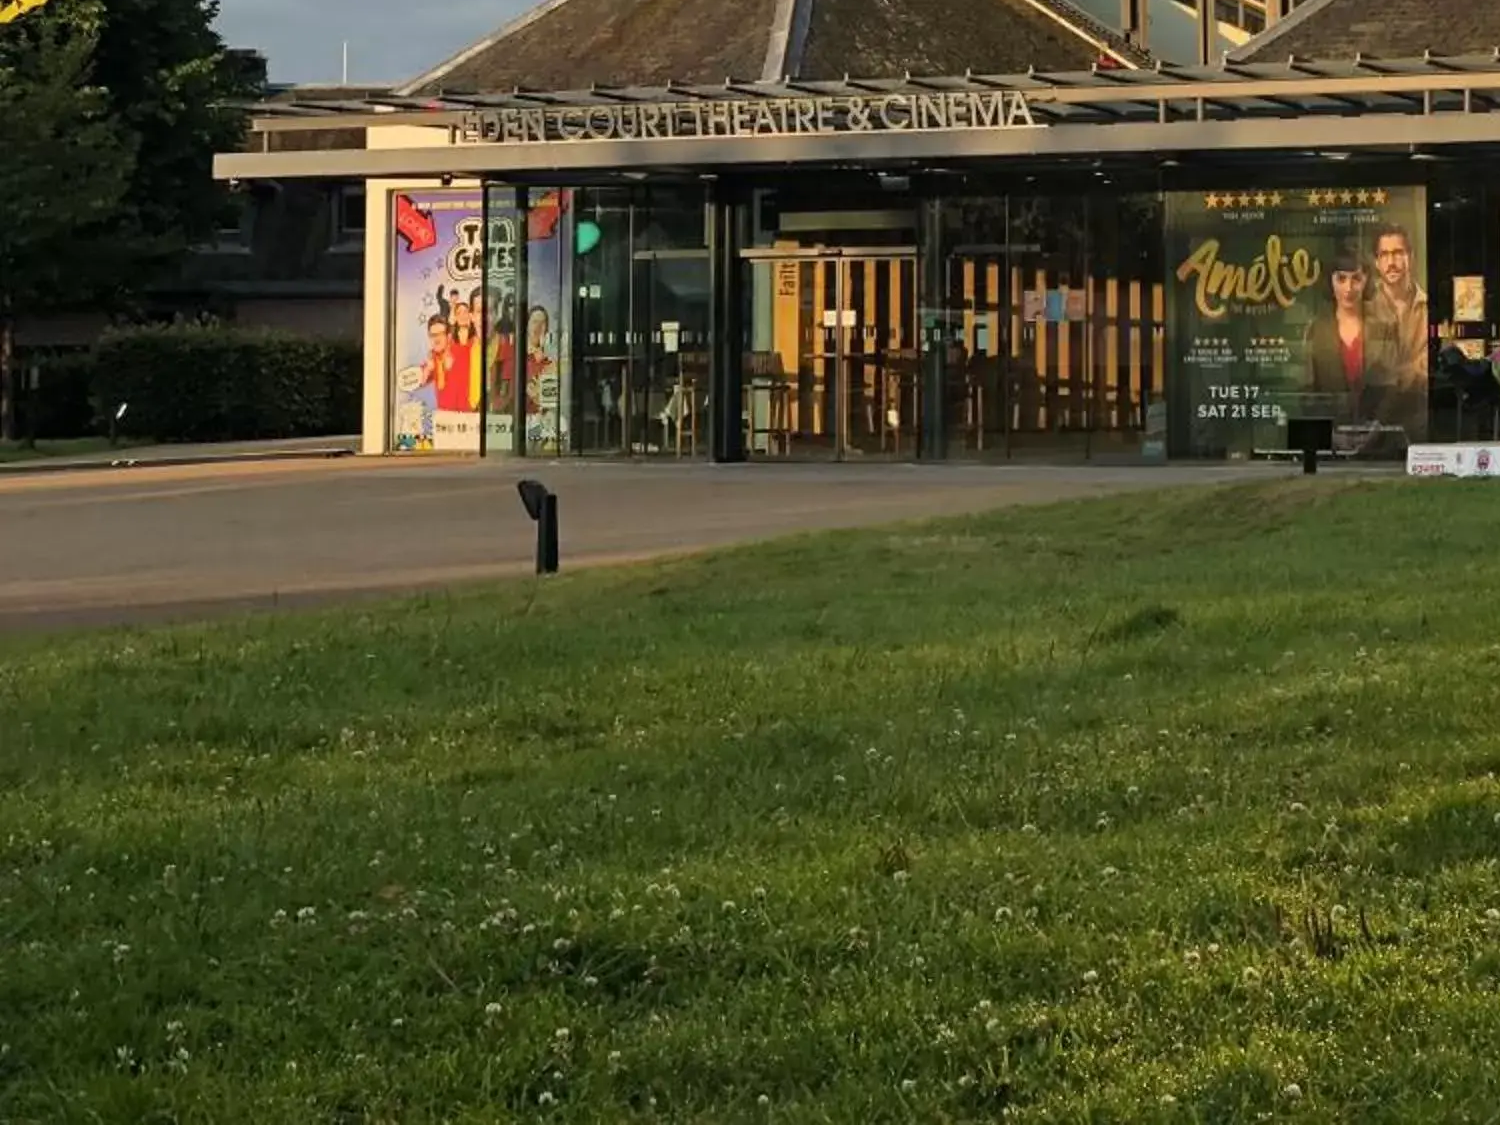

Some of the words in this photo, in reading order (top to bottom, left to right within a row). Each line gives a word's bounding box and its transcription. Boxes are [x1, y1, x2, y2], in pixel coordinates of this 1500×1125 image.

[461, 108, 545, 142] EDEN
[558, 103, 681, 140] COURT
[689, 97, 834, 137] THEATRE
[847, 96, 872, 131] &
[880, 91, 1033, 129] CINEMA
[1176, 235, 1320, 318] Amélie
[1209, 386, 1239, 399] TUE
[1243, 386, 1260, 399] 17
[1197, 405, 1229, 418] SAT
[1231, 405, 1246, 418] 21
